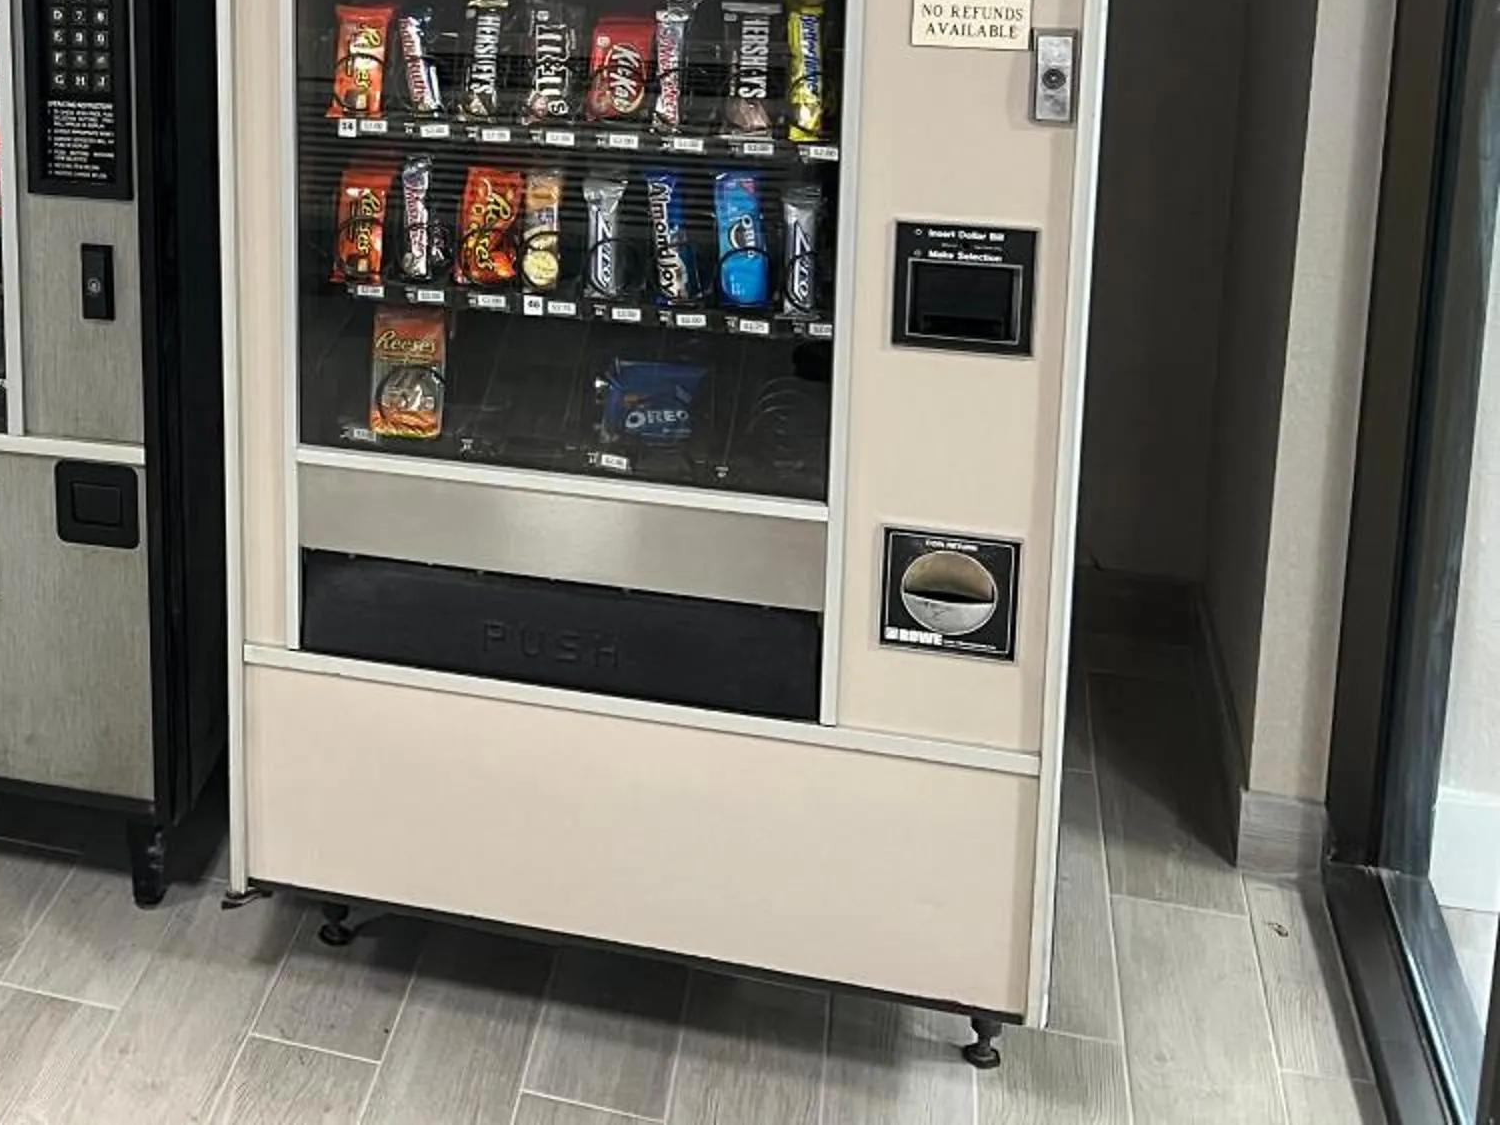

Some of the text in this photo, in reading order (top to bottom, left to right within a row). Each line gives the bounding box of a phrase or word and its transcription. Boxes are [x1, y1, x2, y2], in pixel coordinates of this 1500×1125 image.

[921, 3, 1024, 22] NO REFUNDS
[925, 22, 1018, 39] AVAILABLE
[649, 183, 678, 299] Almond Joy
[928, 229, 1005, 242] Insert Dollar Bill
[928, 250, 1003, 262] Make Selection
[625, 408, 690, 429] OREO
[483, 620, 620, 670] PUSH
[900, 628, 943, 646] ROWE
